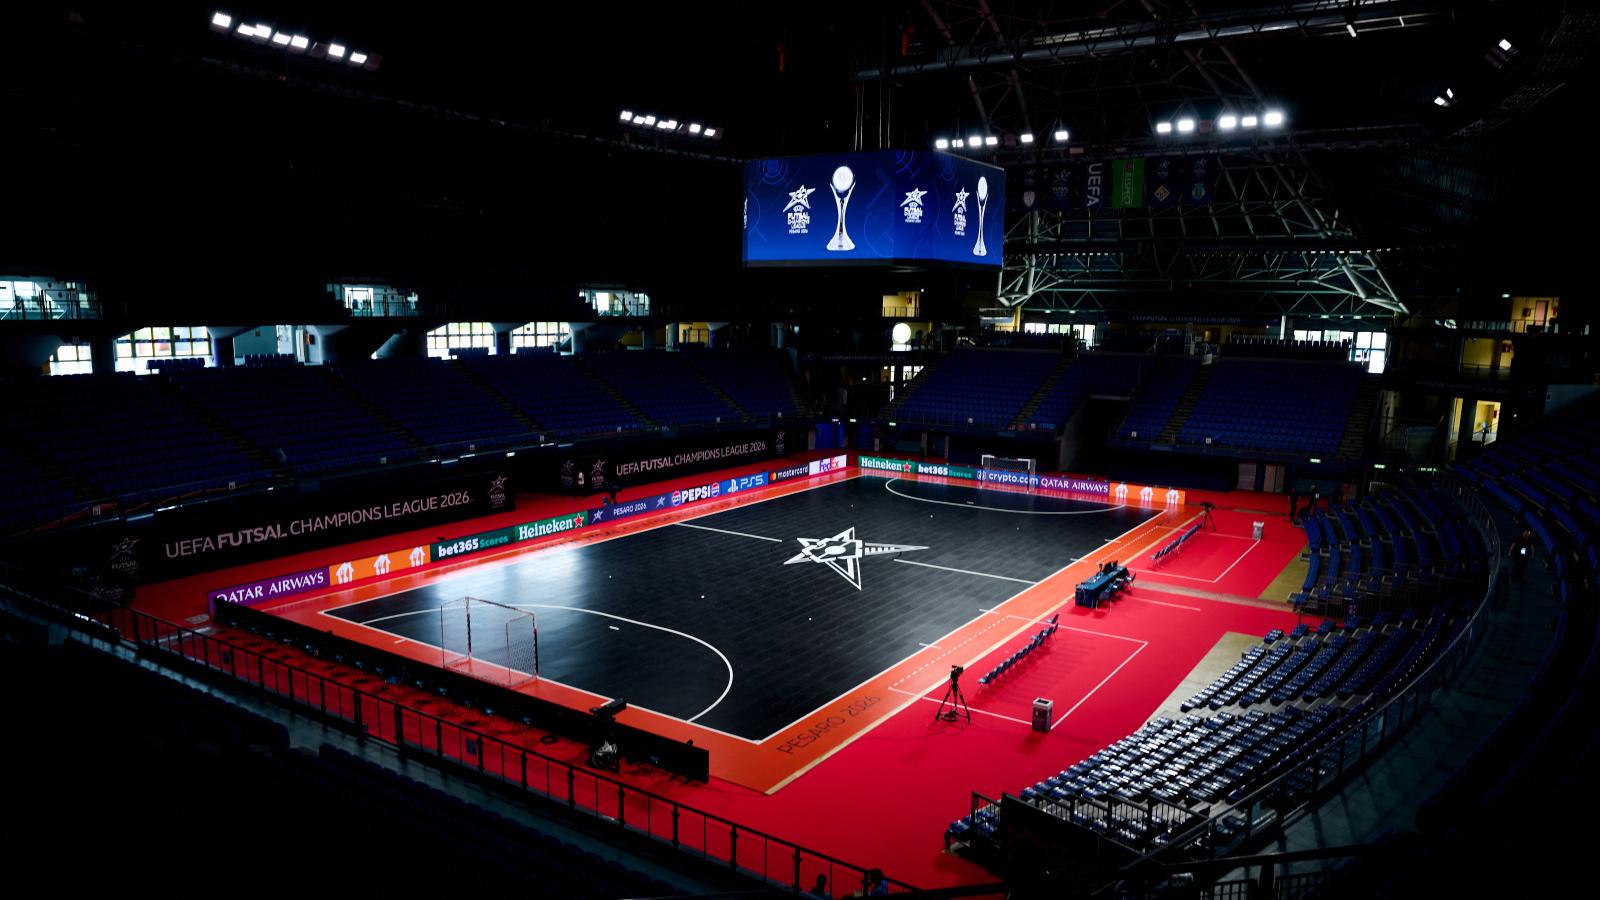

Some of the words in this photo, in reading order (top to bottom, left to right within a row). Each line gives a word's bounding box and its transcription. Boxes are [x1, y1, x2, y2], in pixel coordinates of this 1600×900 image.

[1086, 162, 1103, 207] UEFA
[616, 463, 639, 476] UEFA
[640, 456, 673, 472] FUTSAL
[674, 446, 720, 466] CHAMPIONS
[720, 445, 749, 458] LEAGUE
[750, 441, 766, 451] 2026
[820, 457, 839, 472] FedEx
[861, 457, 902, 471] Heineken
[777, 465, 809, 479] mastercard
[918, 464, 948, 476] bet365
[740, 475, 763, 489] PS5
[1041, 478, 1069, 489] QATAR
[1072, 482, 1109, 493] AIRWAYS
[681, 484, 711, 504] PEPSI
[613, 505, 634, 516] PESARO
[634, 503, 647, 513] 2026
[165, 535, 215, 558] UEFA
[217, 523, 287, 549] FUTSAL
[289, 506, 382, 535] CHAMPIONS
[384, 496, 438, 518] LEAGUE
[440, 491, 470, 508] 2026
[519, 518, 573, 541] Heineken
[438, 538, 479, 558] bet365
[479, 535, 509, 549] Scores
[268, 571, 324, 595] AIRWAYS
[777, 717, 846, 754] PESARO
